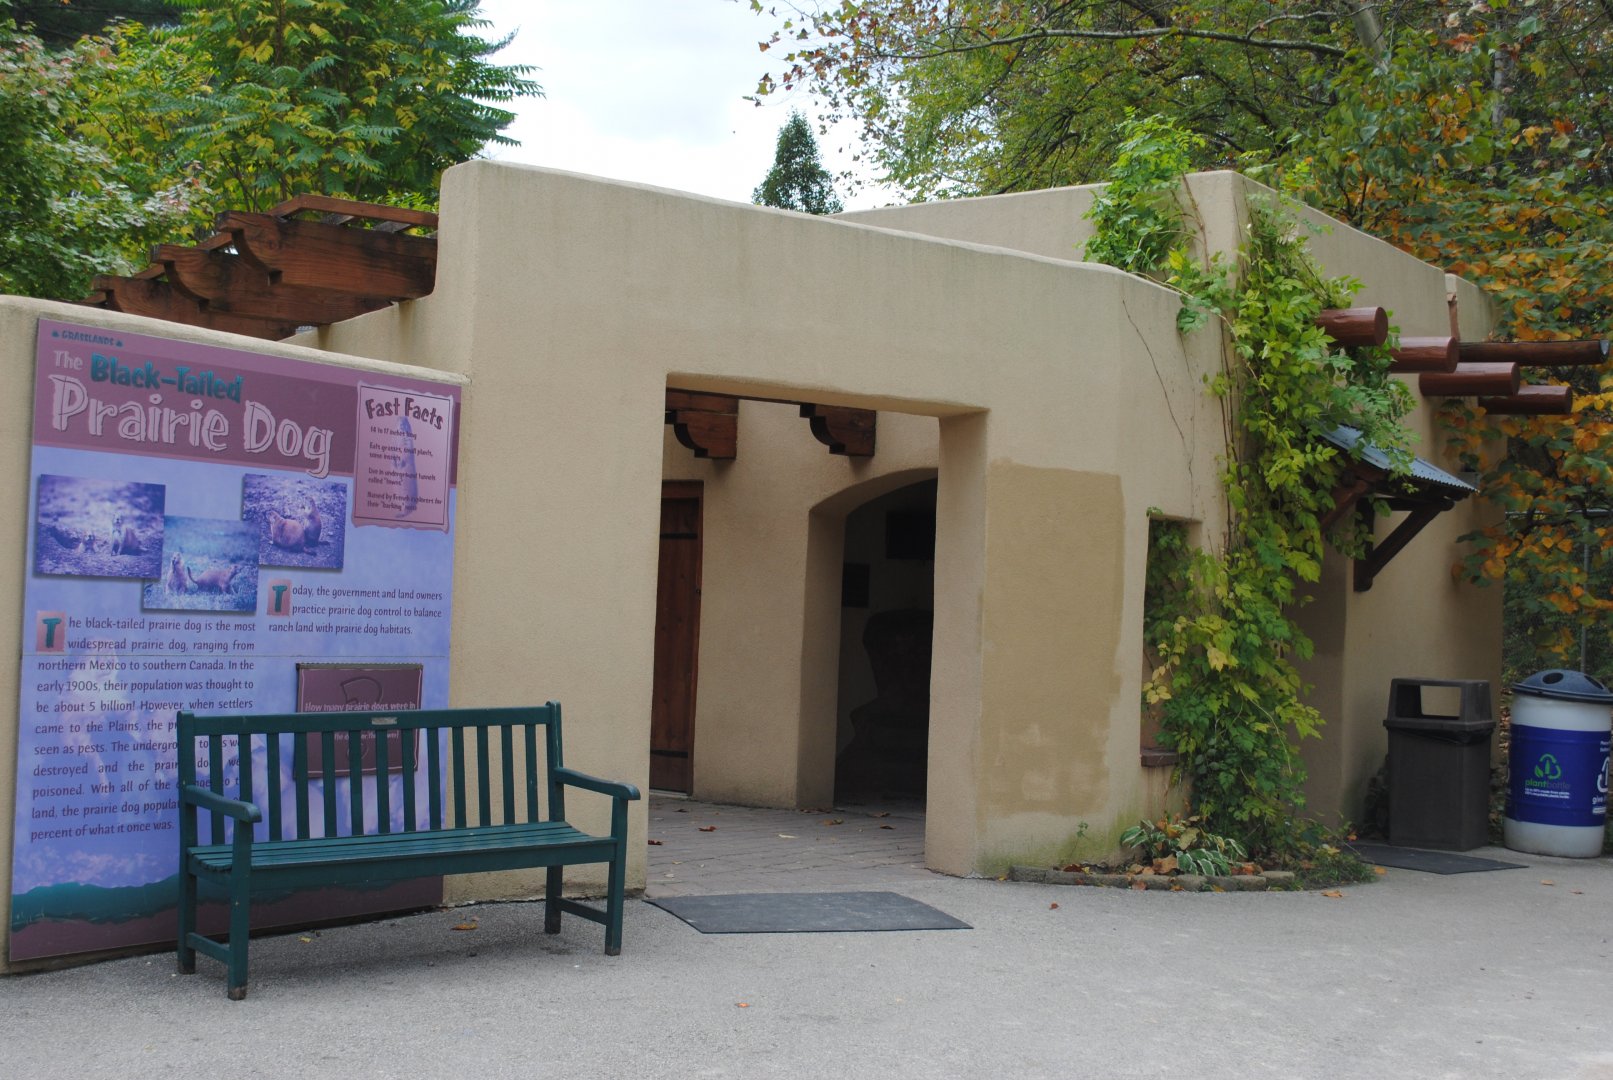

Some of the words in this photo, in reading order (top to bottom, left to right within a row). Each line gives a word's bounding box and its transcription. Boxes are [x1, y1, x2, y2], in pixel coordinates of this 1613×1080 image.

[62, 330, 114, 346] GRASSLANDS
[54, 351, 83, 370] The
[91, 352, 244, 403] Black-Tailed
[365, 397, 400, 419] Fast
[405, 397, 443, 430] Facts
[48, 374, 229, 451] Prairie
[243, 400, 334, 478] Dog
[370, 442, 380, 450] Eats
[316, 586, 330, 596] the
[332, 587, 380, 599] government
[382, 587, 396, 598] and
[398, 588, 414, 600] land
[416, 591, 442, 600] owners
[292, 605, 326, 617] practice
[328, 607, 355, 621] prairie
[357, 605, 372, 618] dog
[374, 605, 402, 617] control
[404, 606, 412, 617] to
[414, 606, 442, 618] balance
[86, 617, 145, 630] black-tailed
[149, 618, 180, 632] prairie
[184, 619, 202, 632] dog
[205, 619, 213, 631] is
[216, 619, 230, 631] the
[234, 621, 256, 632] most
[268, 622, 294, 632] ranch
[295, 622, 314, 633] land
[315, 622, 334, 633] with
[336, 623, 362, 636] prairie
[364, 623, 378, 636] dog
[380, 623, 413, 635] habitats.
[68, 638, 126, 653] widespread
[131, 639, 164, 652] prairie
[168, 639, 188, 652] dog,
[193, 640, 228, 653] ranging
[233, 640, 254, 651] from
[38, 658, 86, 670] northern
[90, 659, 126, 670] Mexico
[129, 660, 140, 670] to
[142, 658, 187, 670] southern
[189, 658, 225, 670] Canada.
[228, 659, 237, 670] In
[239, 658, 254, 670] the
[37, 680, 64, 694] early
[66, 680, 101, 692] 1900s,
[104, 679, 128, 691] their
[130, 678, 182, 694] population
[185, 680, 203, 690] was
[205, 676, 242, 692] thought
[244, 679, 254, 690] to
[36, 701, 49, 713] be
[54, 701, 84, 712] about
[89, 701, 96, 712] 5
[100, 699, 136, 712] billion!
[140, 700, 185, 712] However,
[189, 698, 214, 710] when
[218, 698, 253, 709] settlers
[305, 702, 322, 712] How
[324, 704, 344, 712] many
[346, 702, 369, 711] prairie
[371, 702, 388, 711] dogs
[390, 702, 408, 710] were
[35, 724, 64, 734] came
[69, 722, 80, 732] to
[86, 721, 103, 732] the
[108, 720, 142, 732] Plains,
[147, 718, 163, 730] the
[34, 744, 60, 755] seen
[63, 744, 74, 754] as
[111, 740, 129, 752] The
[132, 739, 178, 754] undergro
[33, 763, 88, 778] destroyed
[98, 761, 118, 773] and
[128, 759, 145, 772] the
[32, 784, 85, 800] poisoned.
[91, 783, 115, 794] With
[120, 781, 133, 792] all
[139, 780, 150, 792] of
[154, 778, 171, 790] the
[32, 808, 58, 819] land,
[62, 806, 79, 817] the
[83, 802, 118, 818] prairie
[121, 802, 140, 815] dog
[144, 799, 178, 815] popula
[30, 826, 72, 843] percent
[75, 824, 87, 837] of
[89, 824, 114, 836] what
[118, 822, 125, 834] it
[127, 822, 150, 832] once
[153, 820, 174, 831] was.
